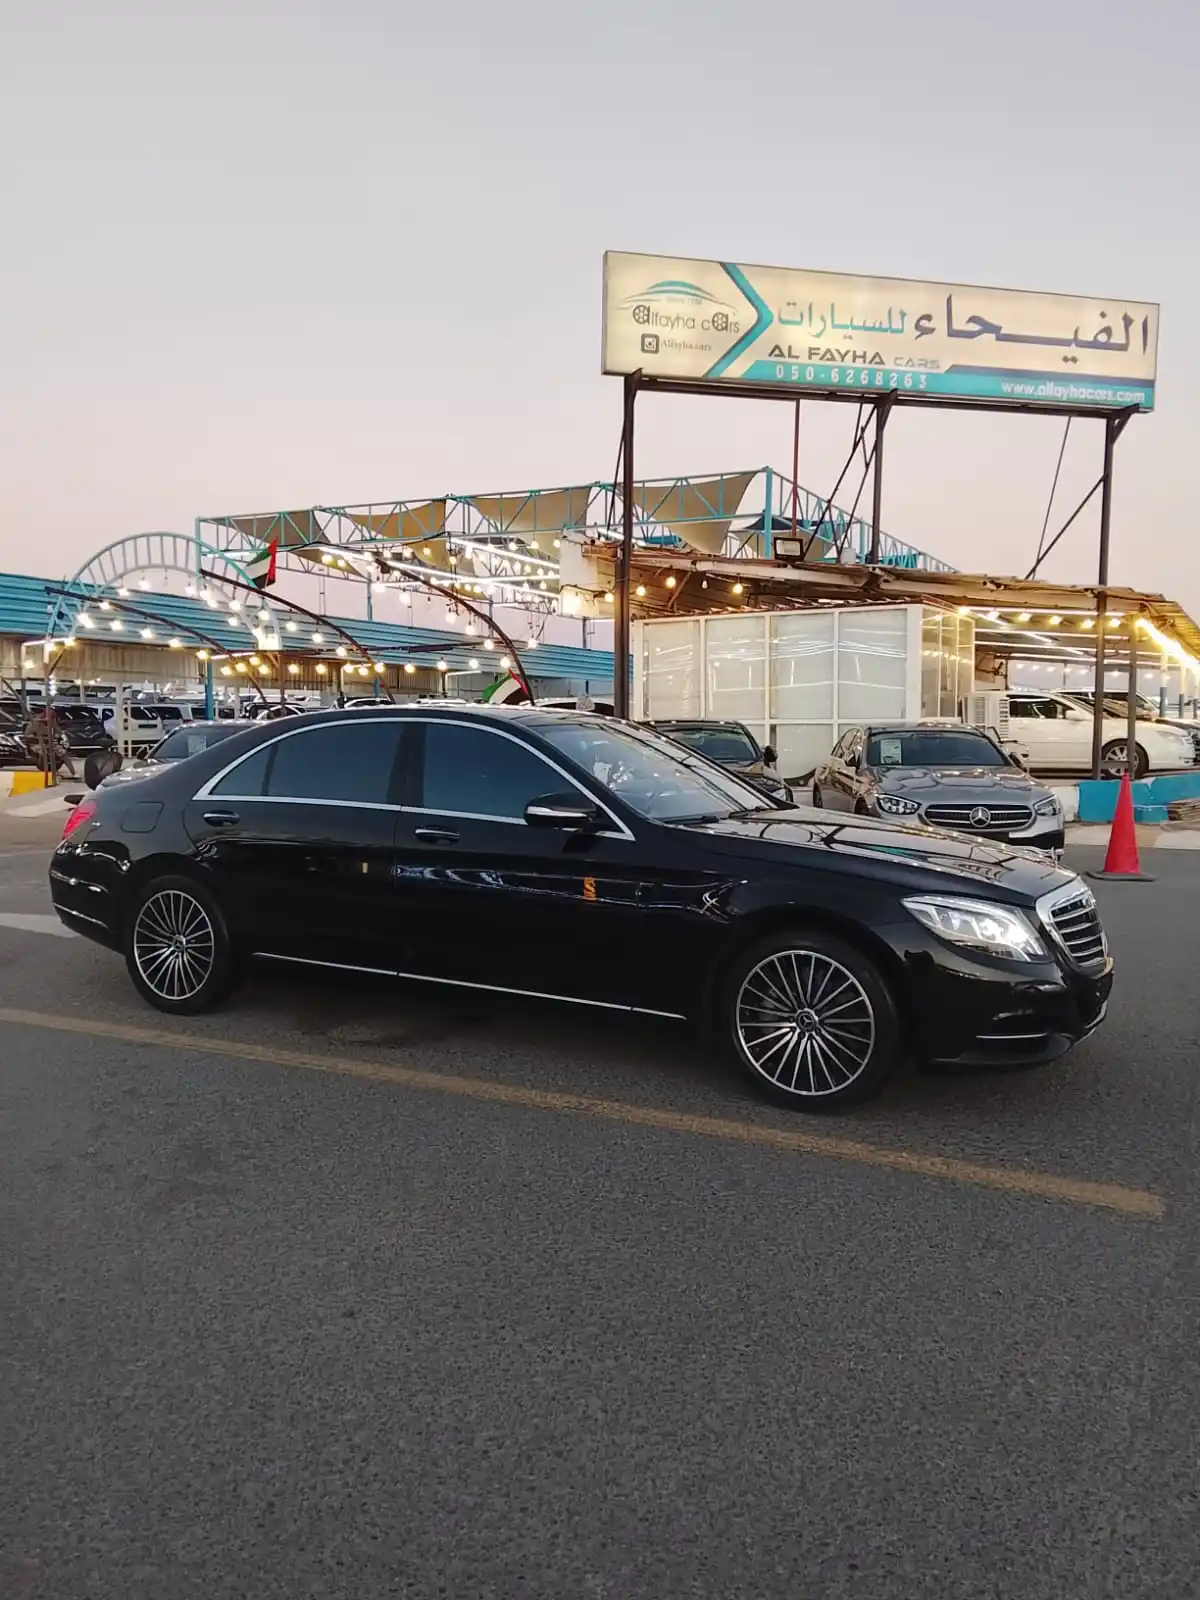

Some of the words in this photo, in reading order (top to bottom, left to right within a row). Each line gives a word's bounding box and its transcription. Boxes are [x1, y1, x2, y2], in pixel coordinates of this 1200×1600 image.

[700, 311, 740, 334] cars
[776, 301, 908, 341] للسيارات
[914, 293, 1149, 365] الفيحاء
[768, 344, 800, 360] AL
[808, 346, 886, 366] FAYHA
[893, 356, 940, 370] CARS
